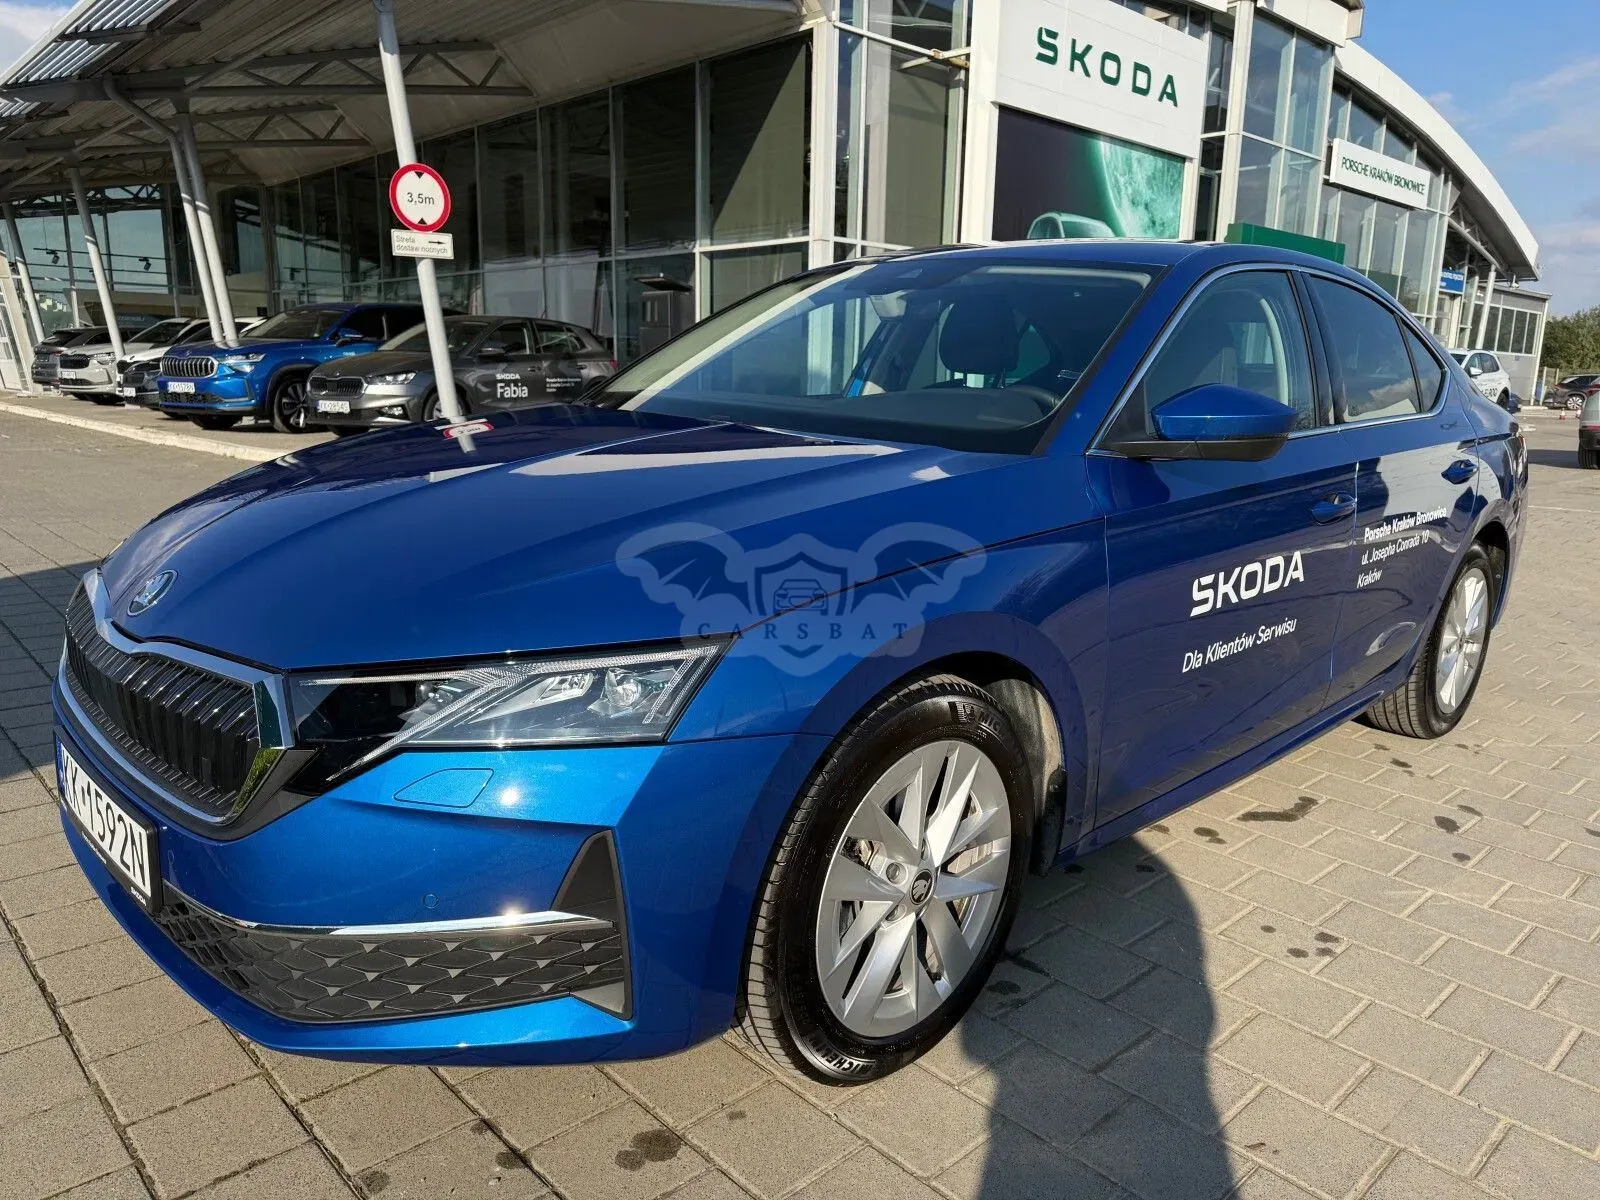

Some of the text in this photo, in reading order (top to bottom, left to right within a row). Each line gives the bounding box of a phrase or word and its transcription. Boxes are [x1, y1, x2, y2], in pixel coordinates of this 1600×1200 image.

[1342, 157, 1425, 195] PORSCHE KRAKÓW BRONOWICE
[407, 191, 435, 206] 3,5m
[497, 383, 528, 399] Fabia
[1364, 522, 1391, 543] Porsche
[1392, 514, 1417, 533] Kraków
[1370, 542, 1396, 562] Josepha
[1396, 533, 1420, 553] Conrada
[1421, 530, 1430, 544] 10
[1356, 568, 1382, 589] Kraków
[1182, 617, 1297, 673] Dla Klientów Serwisu
[87, 781, 146, 887] 1592N
